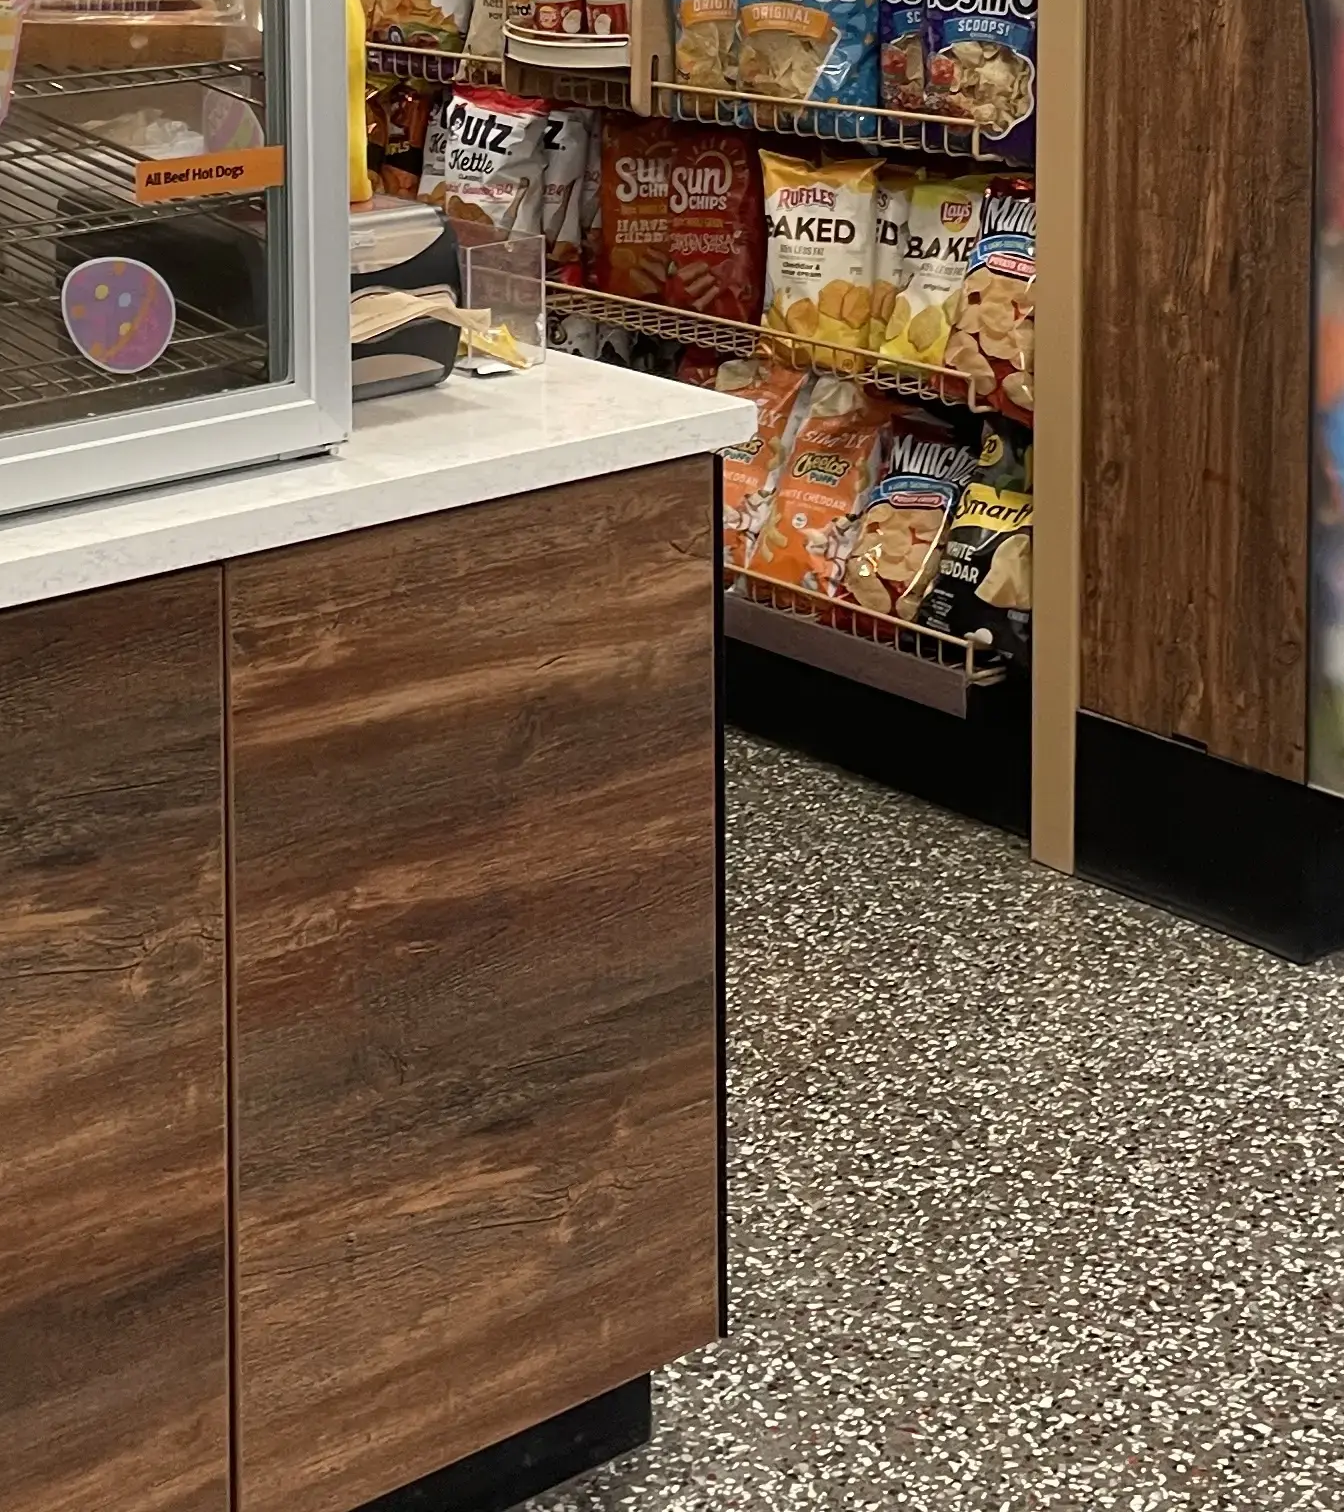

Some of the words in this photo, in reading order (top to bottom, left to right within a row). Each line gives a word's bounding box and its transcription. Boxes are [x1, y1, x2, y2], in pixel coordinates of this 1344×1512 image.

[752, 5, 811, 25] ORIGINAL
[957, 19, 1010, 37] SCOOPS!
[448, 148, 494, 176] Kettle
[145, 172, 162, 188] All
[164, 168, 190, 185] Beef
[192, 167, 214, 181] Hot
[216, 165, 245, 180] Dogs
[670, 164, 730, 214] Sun
[776, 187, 837, 211] RUFFLES
[689, 195, 727, 210] CHIPS
[941, 201, 972, 223] Lay's
[617, 218, 668, 232] HARVE
[765, 214, 857, 245] BAKED
[904, 236, 974, 262] BAKE
[791, 452, 851, 478] Cheetos
[805, 492, 847, 510] CHEDDAR
[955, 488, 1033, 529] Smartf
